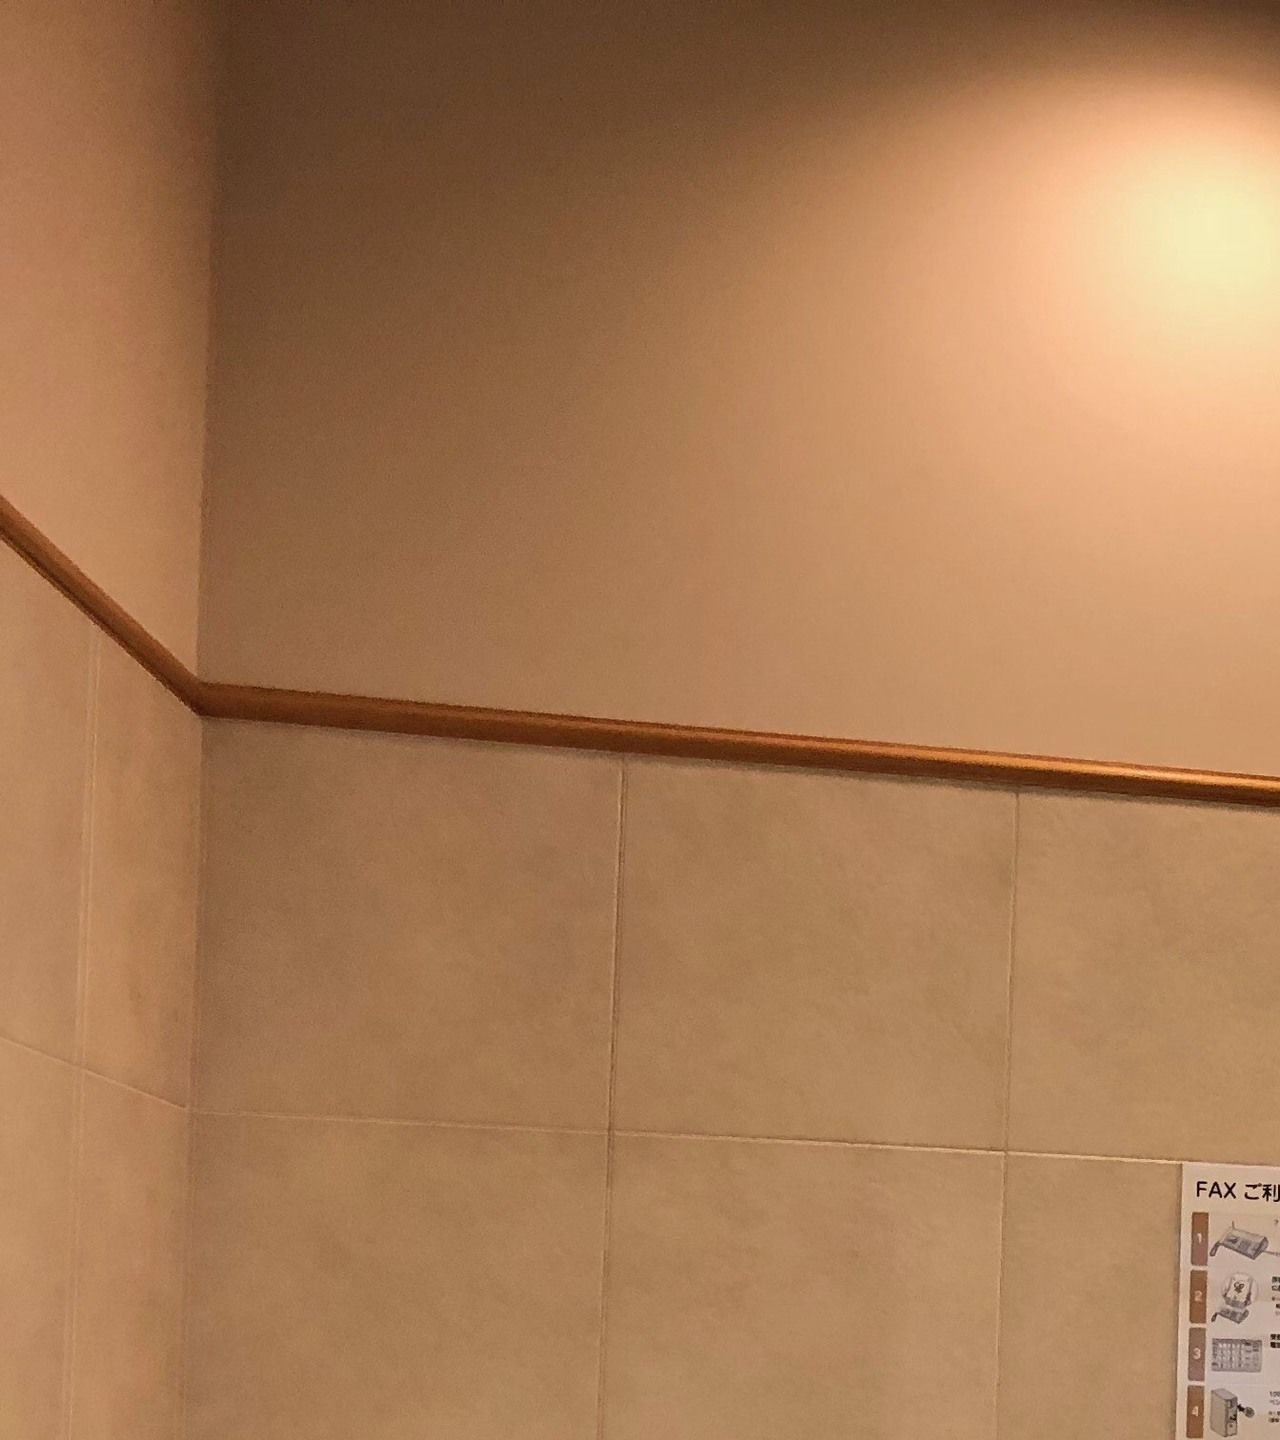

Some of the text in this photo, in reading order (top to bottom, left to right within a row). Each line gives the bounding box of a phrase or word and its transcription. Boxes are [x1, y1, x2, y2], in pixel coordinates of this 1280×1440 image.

[1196, 1181, 1237, 1199] FAX
[1193, 1348, 1201, 1359] 3
[1191, 1405, 1199, 1417] 4
